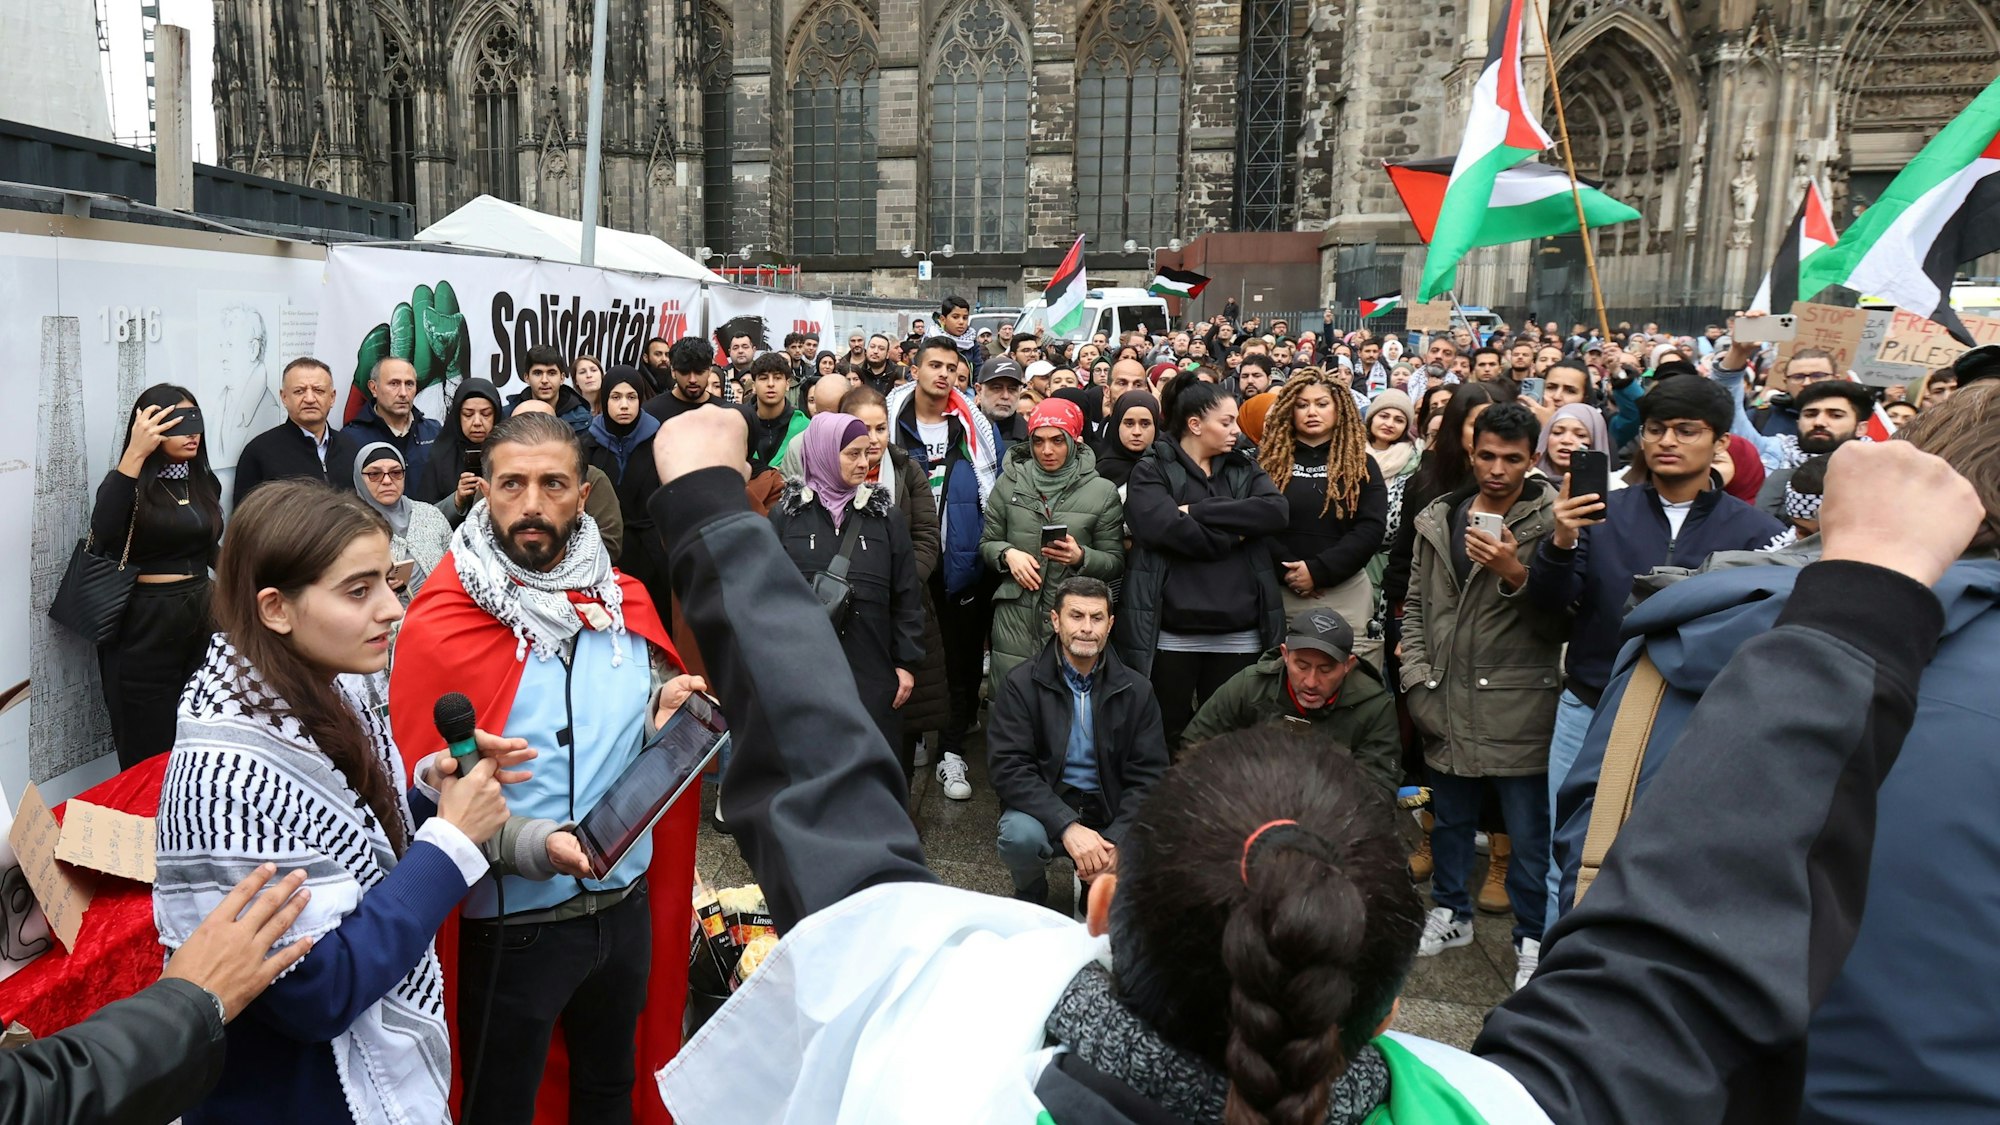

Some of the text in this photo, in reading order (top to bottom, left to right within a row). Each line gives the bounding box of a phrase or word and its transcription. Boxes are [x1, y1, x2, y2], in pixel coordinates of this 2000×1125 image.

[98, 304, 162, 343] 1816
[1803, 306, 1856, 324] STOP
[490, 291, 688, 387] Solidarität für
[1815, 328, 1843, 343] THE
[926, 443, 945, 455] RE
